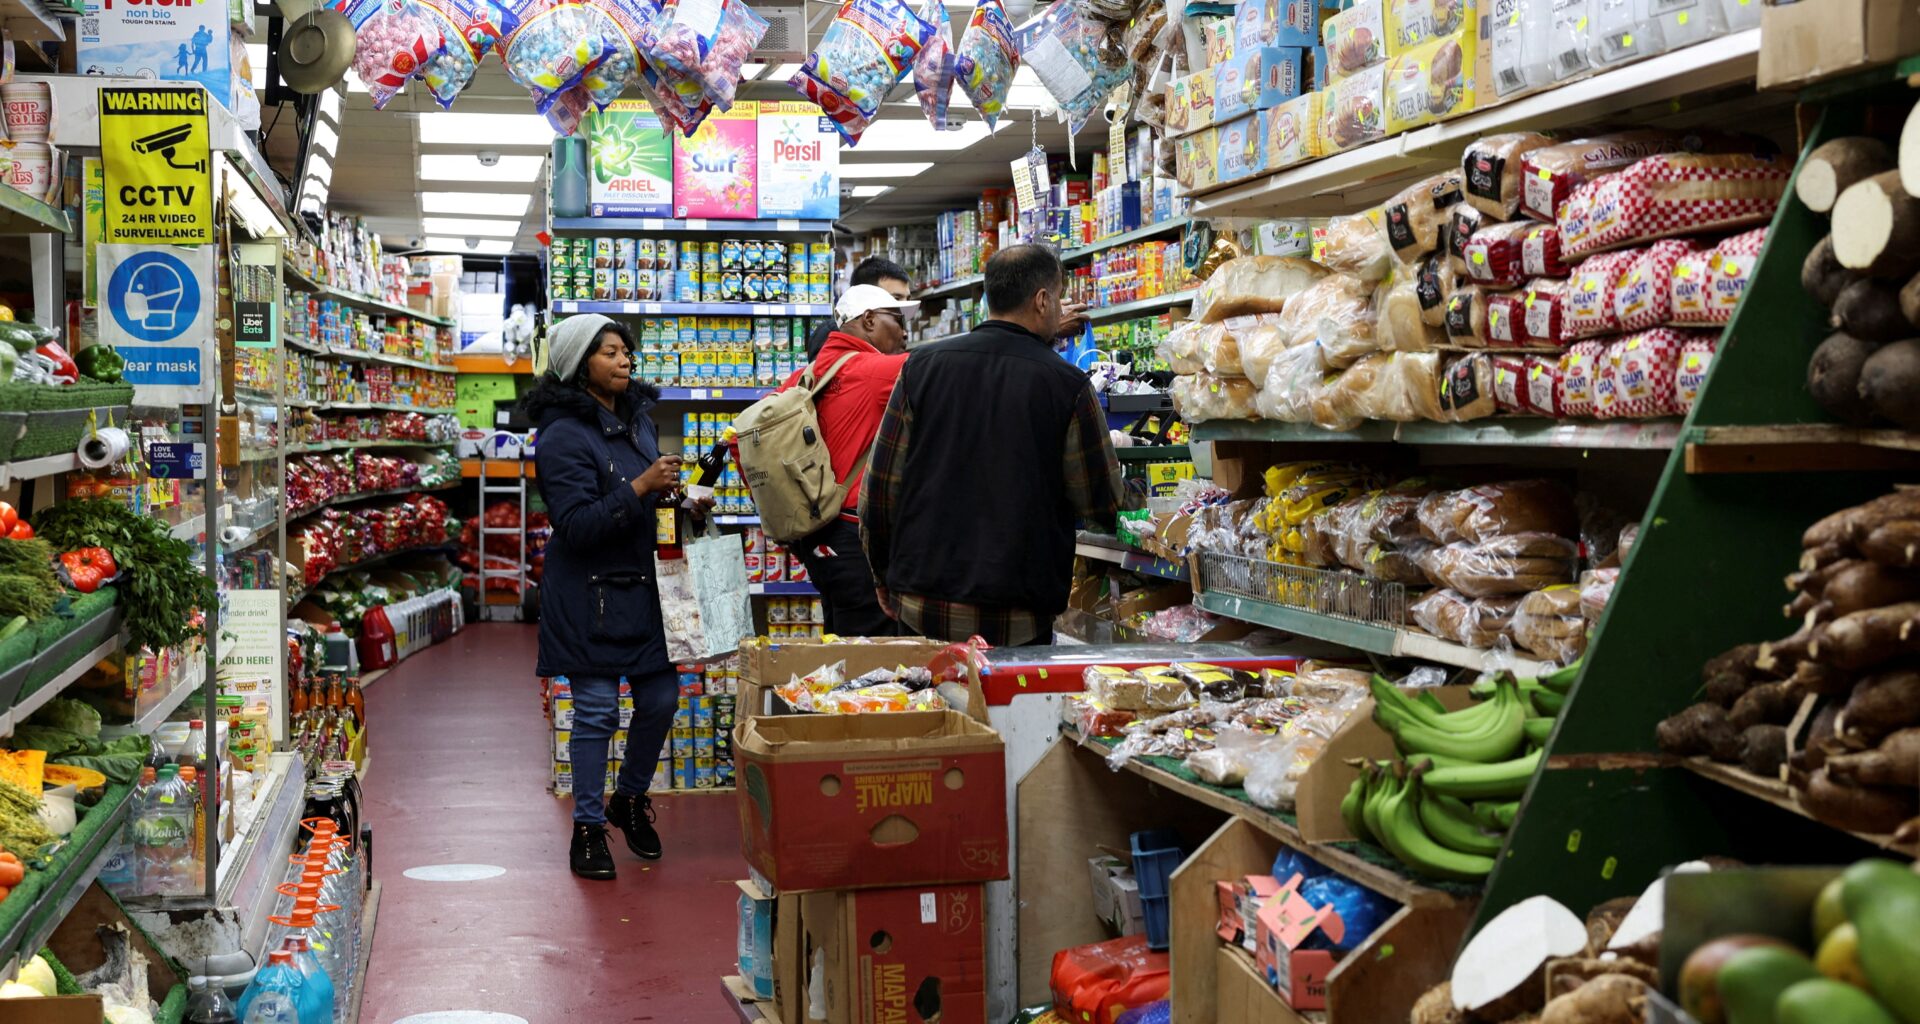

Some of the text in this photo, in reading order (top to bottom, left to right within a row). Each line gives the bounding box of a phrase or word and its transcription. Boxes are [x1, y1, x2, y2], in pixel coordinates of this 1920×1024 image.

[126, 9, 171, 19] non bio
[1397, 19, 1421, 46] EASTER
[1240, 36, 1252, 49] SPICE
[107, 92, 201, 110] WARNING
[736, 102, 753, 110] CLEAN
[1220, 96, 1232, 109] SPICE
[1391, 94, 1417, 121] EASTER
[9, 102, 39, 114] CUP
[7, 112, 48, 126] OODLES
[774, 140, 821, 164] Persil
[692, 153, 738, 174] Surf
[608, 179, 656, 191] ARIEL
[120, 185, 195, 207] CCTV
[122, 214, 196, 223] 24 HR VIDEO
[114, 229, 205, 238] SURVEILLANCE
[1716, 279, 1747, 292] GIANT
[1573, 291, 1597, 304] GIANT
[243, 318, 263, 327] Uber
[123, 361, 197, 372] ear mask
[1565, 376, 1586, 389] GIANT
[1622, 369, 1644, 386] GIANT
[220, 656, 274, 665] SOLD HERE!
[854, 771, 932, 785] PREMIUM PLANTAINS
[856, 782, 933, 814] MAPALÉ
